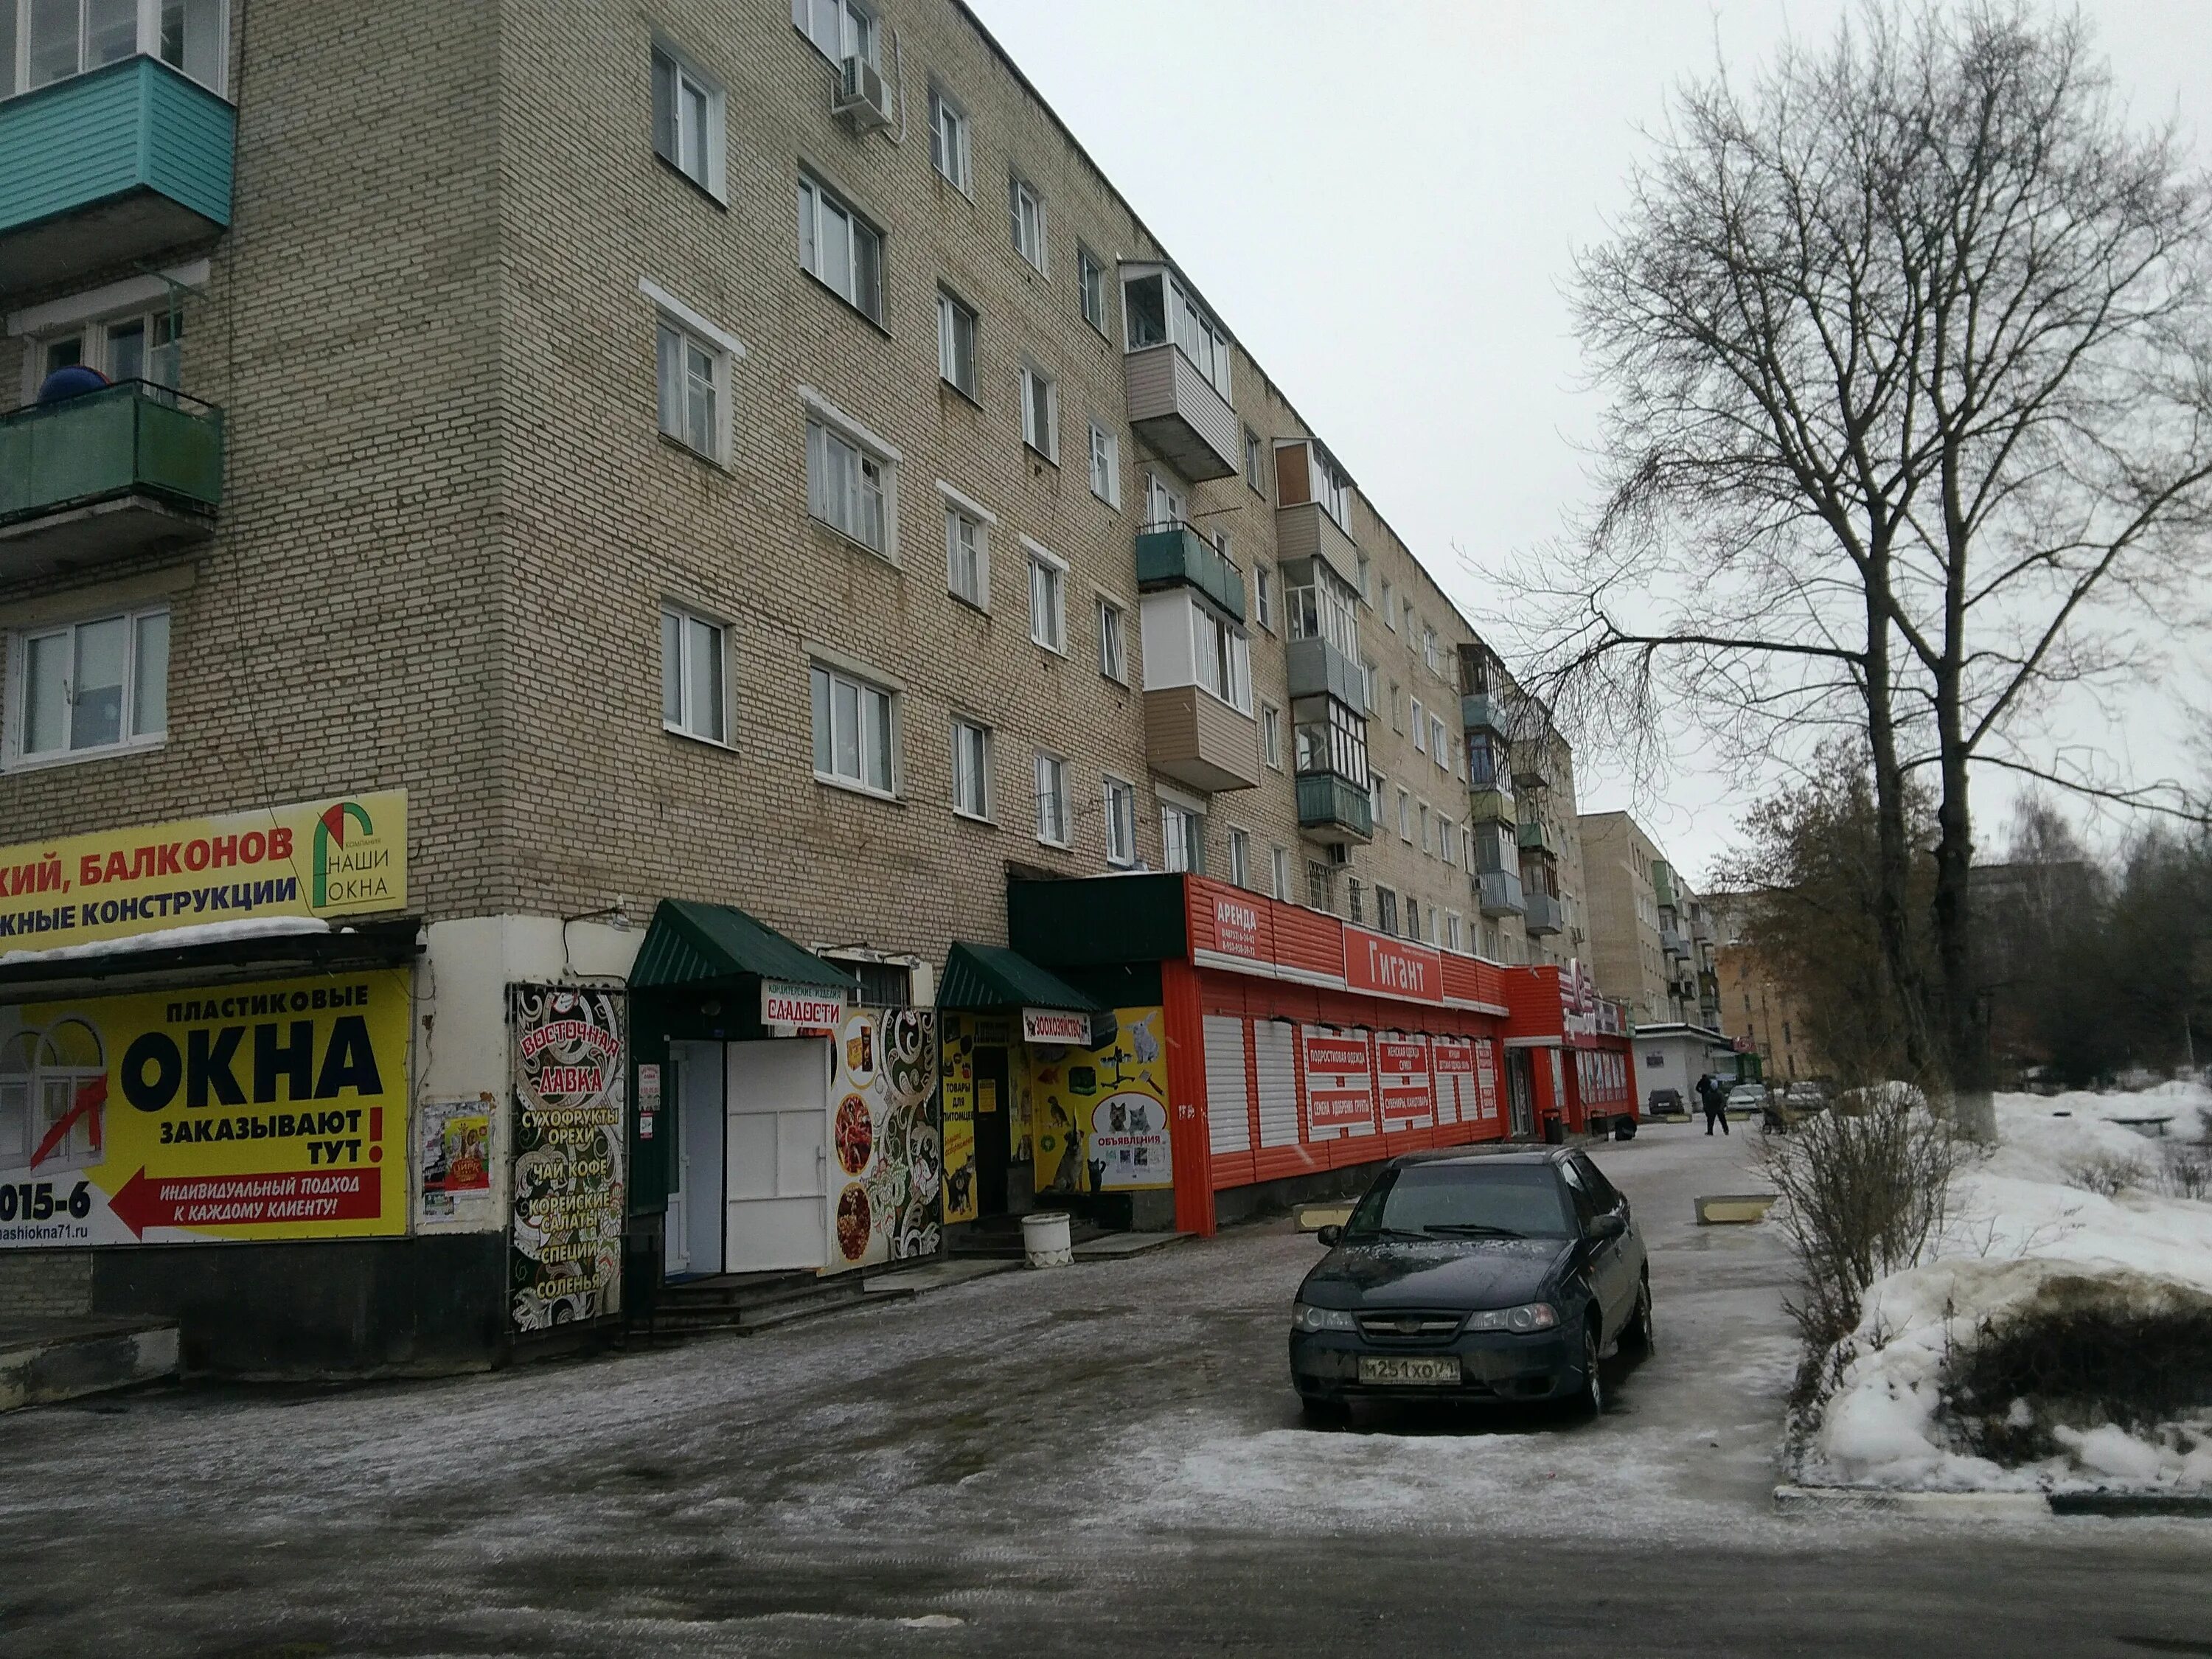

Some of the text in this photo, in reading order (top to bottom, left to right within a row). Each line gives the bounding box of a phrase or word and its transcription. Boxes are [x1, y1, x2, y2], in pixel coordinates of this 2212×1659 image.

[345, 838, 381, 848] КОМПАНИЯ
[80, 827, 293, 886] БАЛКОНОВ
[328, 849, 389, 875] НАШИ
[81, 876, 296, 926] КОНСТРУКЦИИ
[328, 877, 388, 901] ОКНА
[1217, 901, 1257, 933] АРЕНДА
[1368, 939, 1424, 992] Гигант
[166, 985, 368, 1023] ПЛАСТИКОВЫЕ
[768, 984, 841, 1000] КОНДИТЕРСКИЕ ИЗДЕЛИЯ
[768, 998, 841, 1026] СЛАДОСТИ
[520, 1019, 622, 1060] ВОСТОЧНАЯ
[1035, 1015, 1081, 1039] ЗООХОЗЯЙСТВО
[120, 1015, 384, 1113] ОКНА
[1310, 1049, 1366, 1065] ПОДРОСТКОВАЯ ОДЕЖДА
[538, 1065, 604, 1094] ЛАВКА
[946, 1082, 971, 1093] ТОВАРЫ
[953, 1096, 965, 1109] ДЛЯ
[160, 1110, 361, 1144] ЗАКАЗЫВАЮТ
[521, 1107, 619, 1129] СУХОФРУКТЫ
[547, 1127, 595, 1145] ОРЕХИ
[1098, 1135, 1161, 1147] ОБЪЯВЛЕНИЯ
[533, 1158, 608, 1181] ЧАЙ КОФЕ
[159, 1175, 360, 1201] ИНДИВИДУАЛЬНЫЙ ПОДХОД
[173, 1197, 338, 1222] К КАЖДОМУ КЛИЕНТУ!
[528, 1191, 611, 1216] КОРЕЙСКИЕ
[540, 1210, 599, 1234] САЛАТЫ
[540, 1239, 599, 1265] СПЕЦИИ
[535, 1272, 601, 1299] СОЛЕНЬЯ
